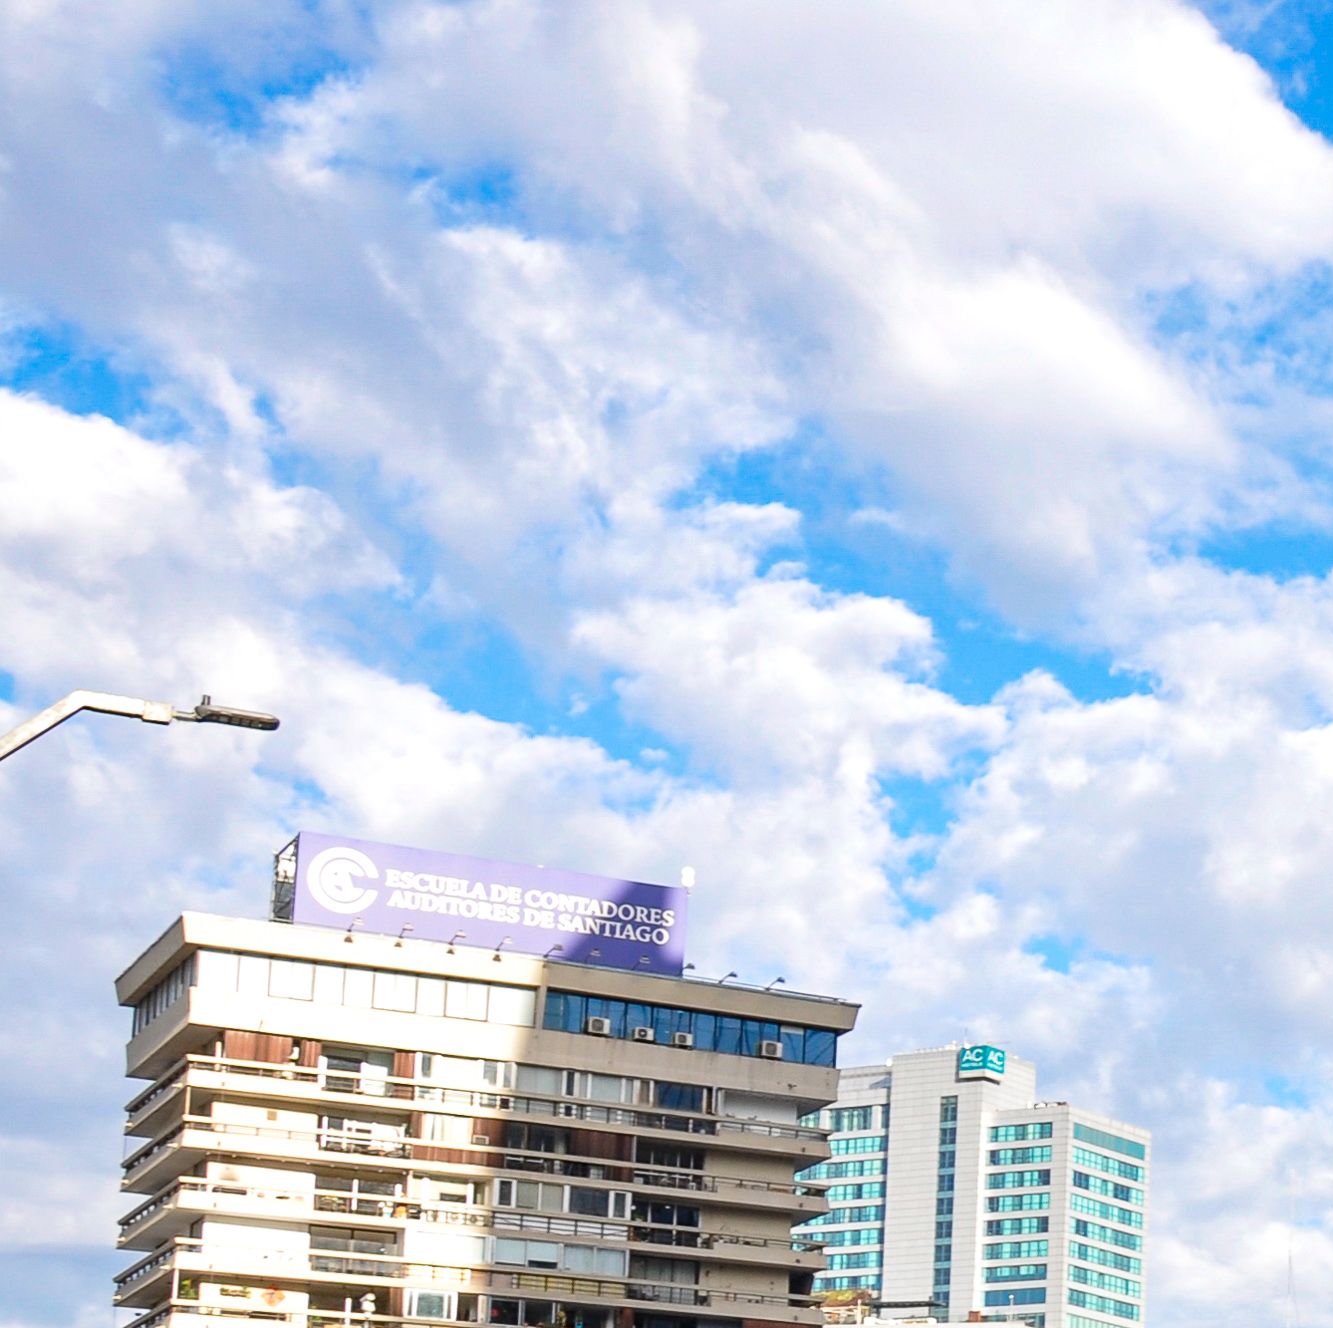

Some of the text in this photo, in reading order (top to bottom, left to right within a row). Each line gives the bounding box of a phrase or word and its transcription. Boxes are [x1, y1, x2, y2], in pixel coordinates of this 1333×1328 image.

[385, 868, 675, 927] ESCUELA DE CONTADORES
[387, 889, 670, 945] AUDITORES DE SANTIAGO
[962, 1048, 983, 1063] AC
[987, 1050, 1004, 1066] AC
